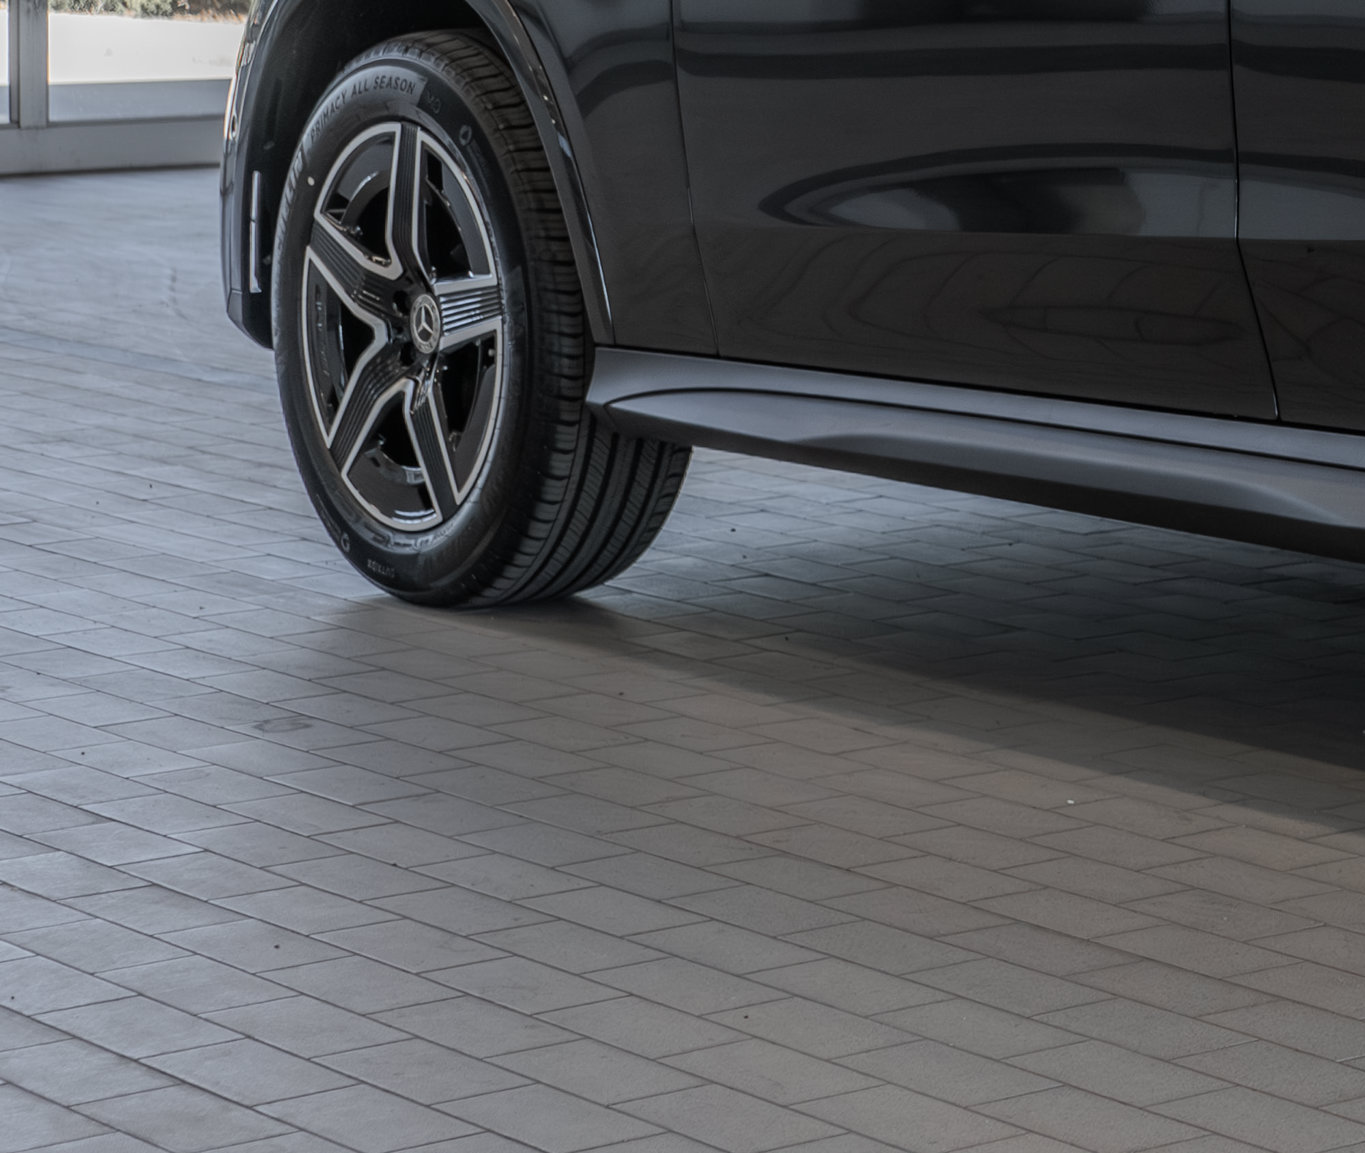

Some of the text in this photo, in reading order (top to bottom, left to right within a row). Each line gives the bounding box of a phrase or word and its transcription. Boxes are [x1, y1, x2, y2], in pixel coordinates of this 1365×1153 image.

[310, 89, 347, 144] PRIMACY
[351, 79, 369, 98] ALL
[373, 75, 416, 95] SEASON
